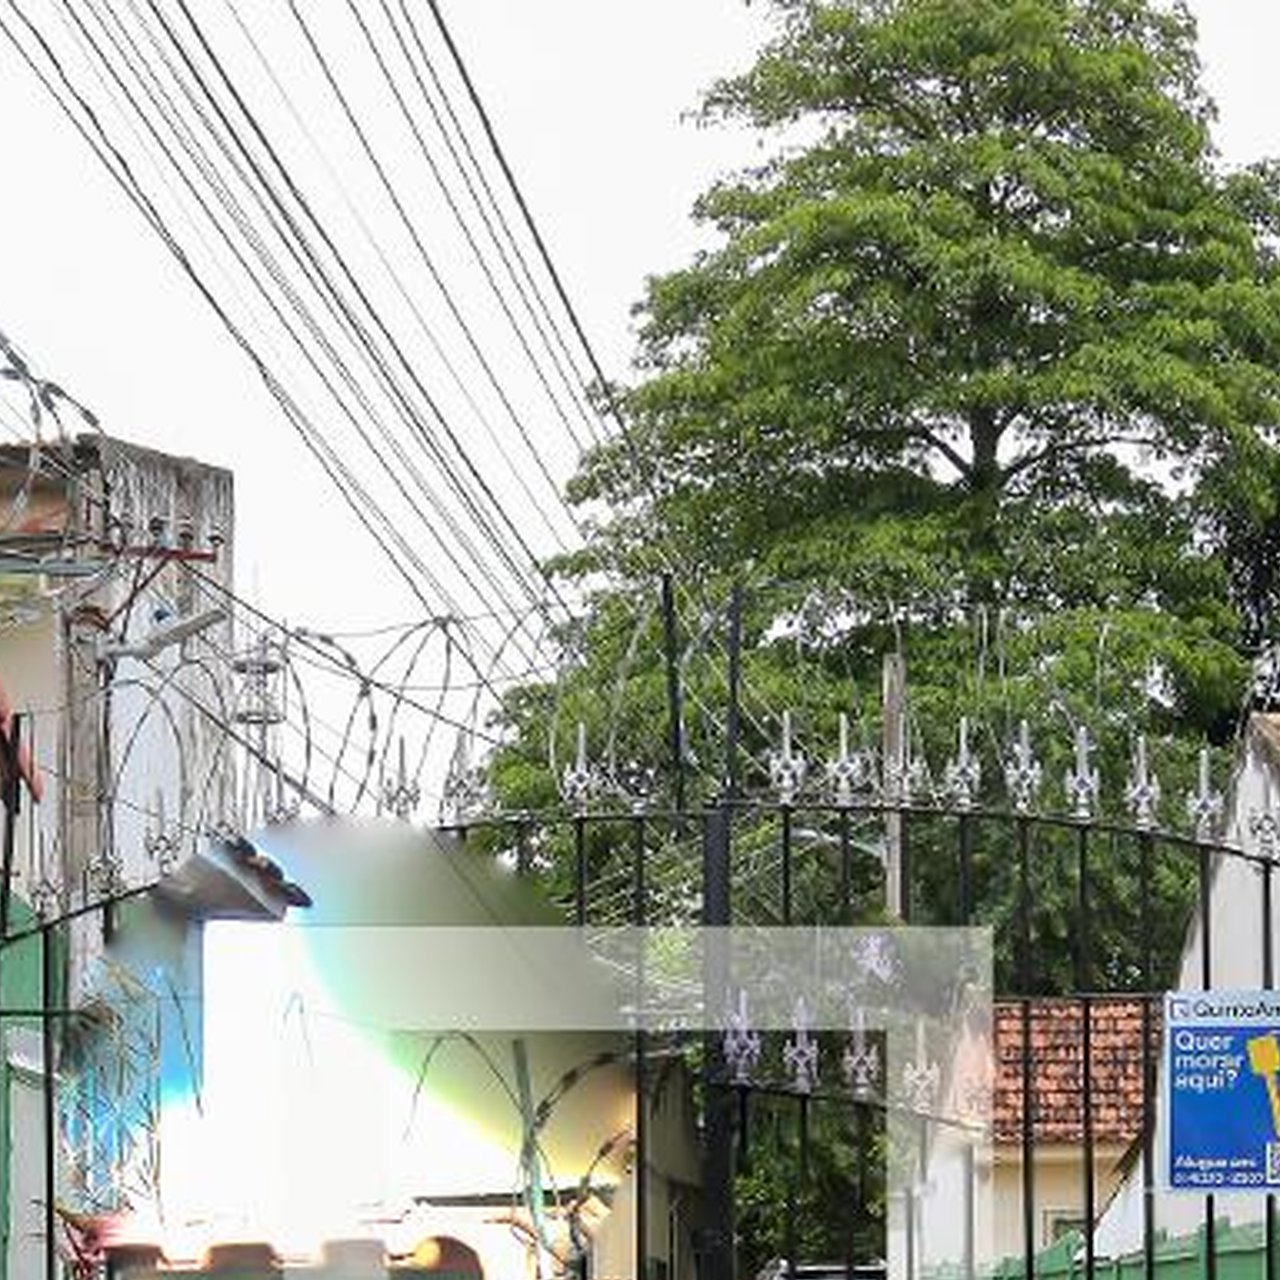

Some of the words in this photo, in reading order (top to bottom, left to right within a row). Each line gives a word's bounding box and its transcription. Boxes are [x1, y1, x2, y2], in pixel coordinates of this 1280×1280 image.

[1175, 1030, 1234, 1051] Quer
[1175, 1055, 1245, 1070] morar
[1174, 1069, 1238, 1095] aqui?
